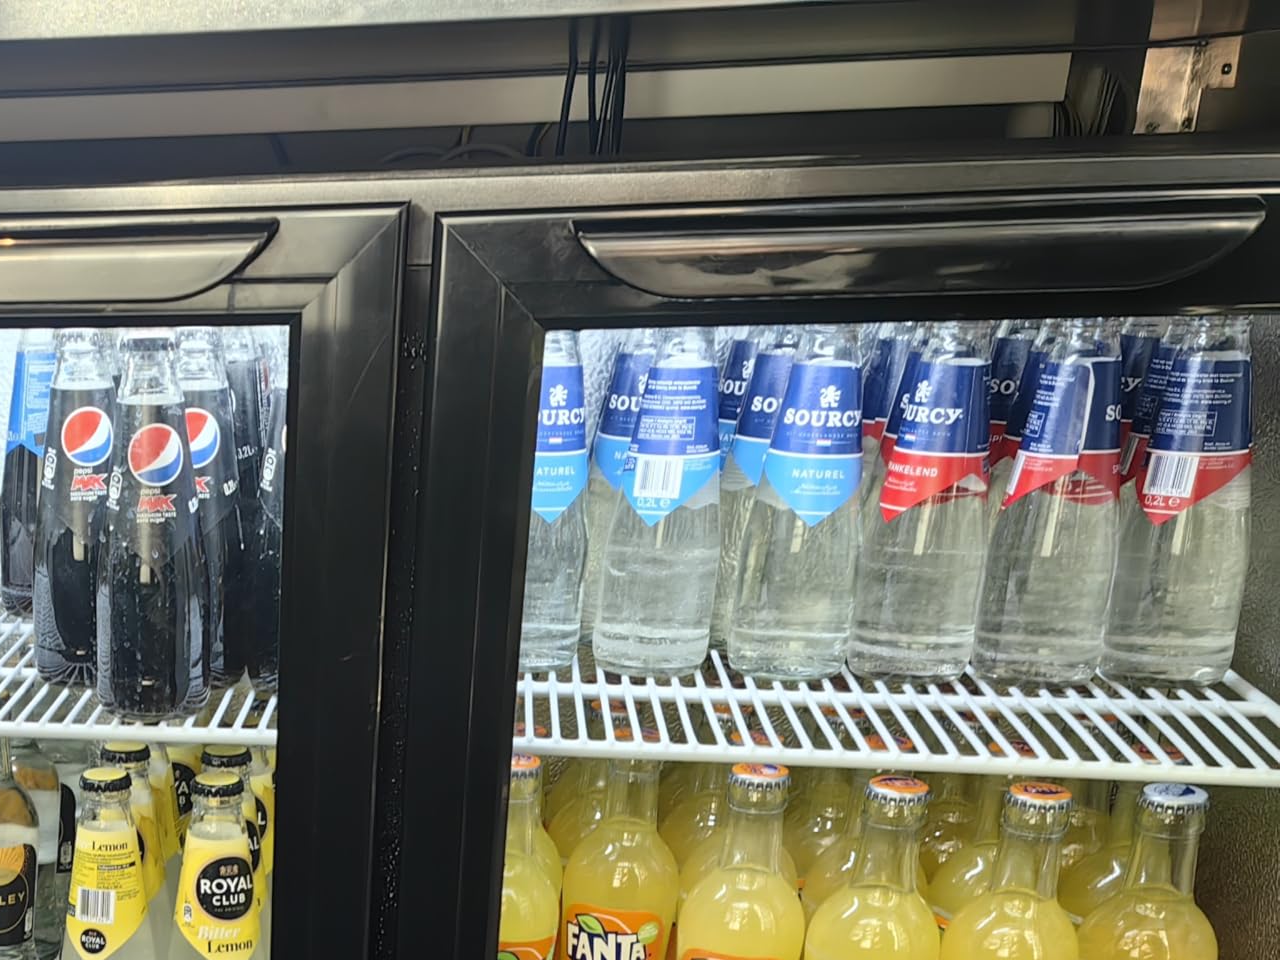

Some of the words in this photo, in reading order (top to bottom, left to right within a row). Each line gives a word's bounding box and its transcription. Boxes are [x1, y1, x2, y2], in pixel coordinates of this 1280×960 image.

[783, 408, 862, 427] SOURCY
[536, 466, 576, 476] ATUREL
[791, 468, 846, 479] NATUREL
[1144, 495, 1165, 507] 0,2L
[92, 840, 128, 851] Lemon
[200, 875, 252, 895] ROYAL
[212, 895, 246, 907] CLUB
[81, 934, 106, 946] ROYAL
[207, 939, 253, 953] Lemon
